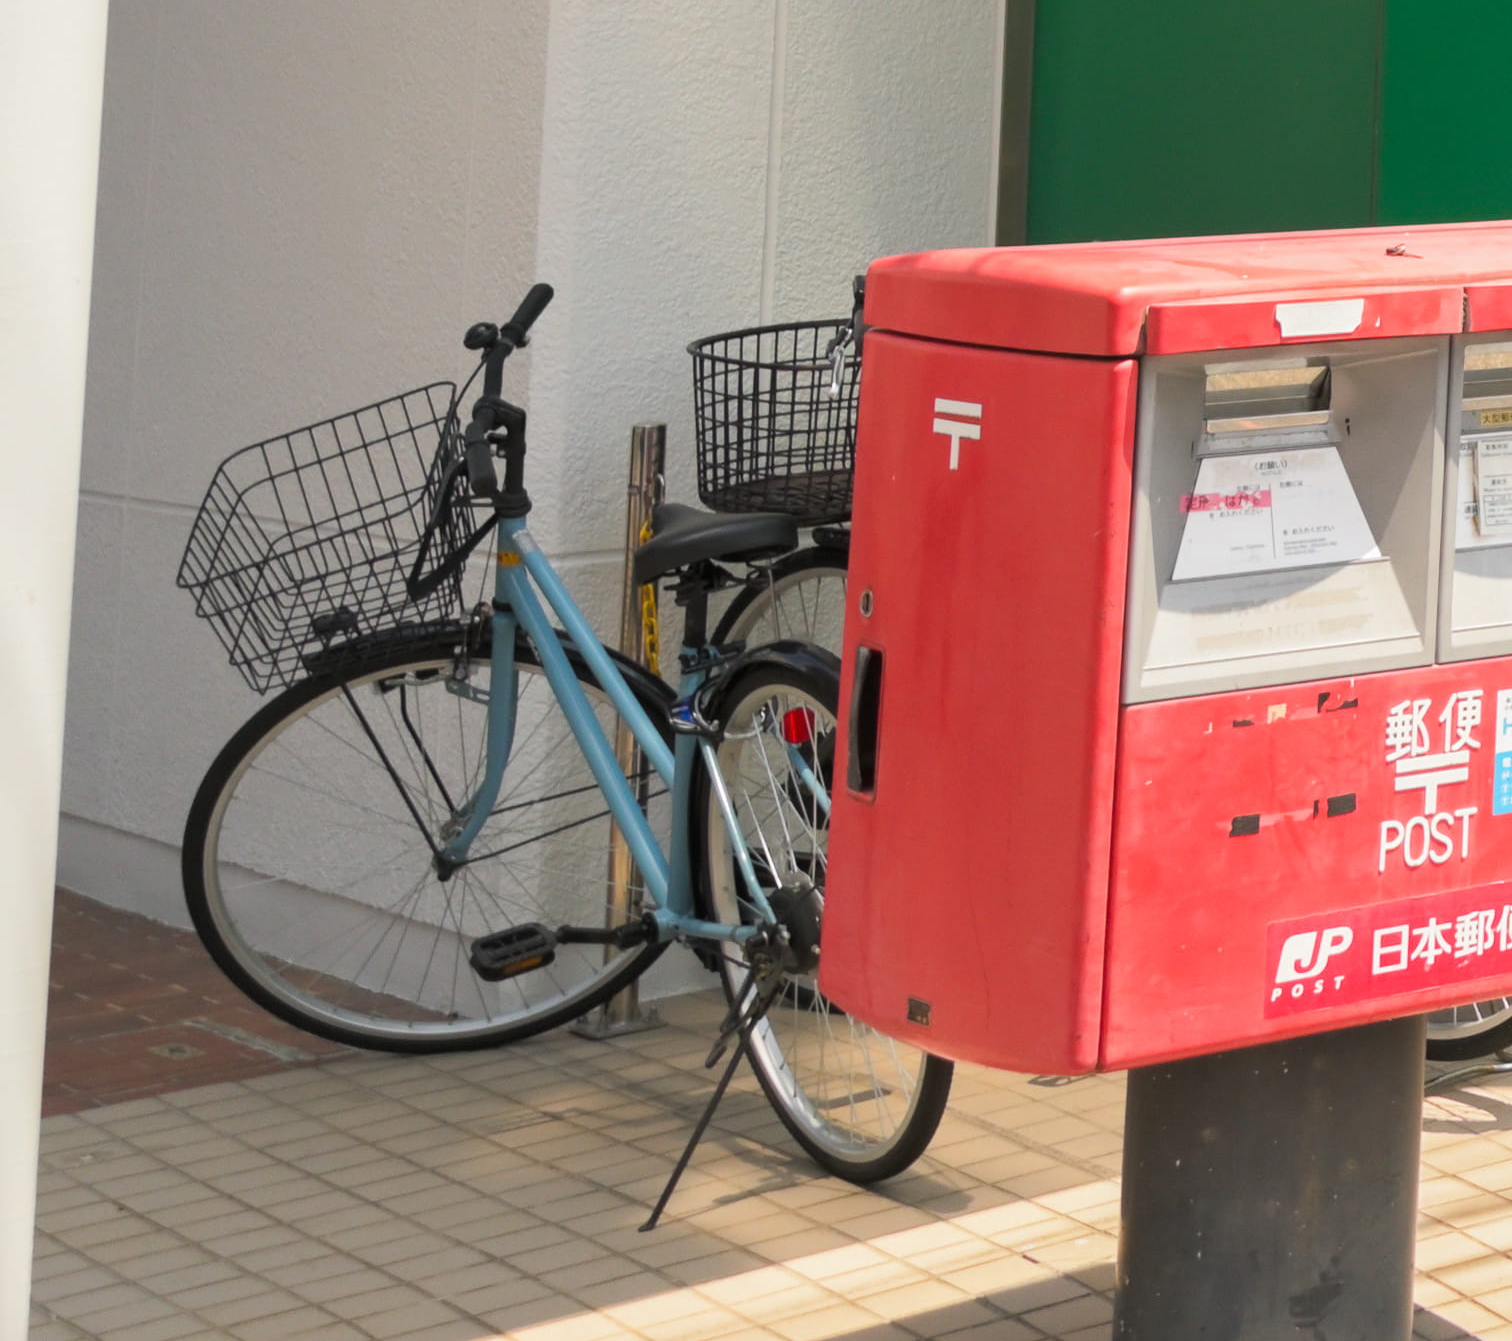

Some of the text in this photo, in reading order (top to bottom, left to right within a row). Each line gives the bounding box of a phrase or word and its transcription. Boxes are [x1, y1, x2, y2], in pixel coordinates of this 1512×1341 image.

[1386, 689, 1484, 763] 郵便
[1378, 806, 1479, 873] POST
[1274, 925, 1354, 984] JP
[1270, 975, 1345, 1003] POST
